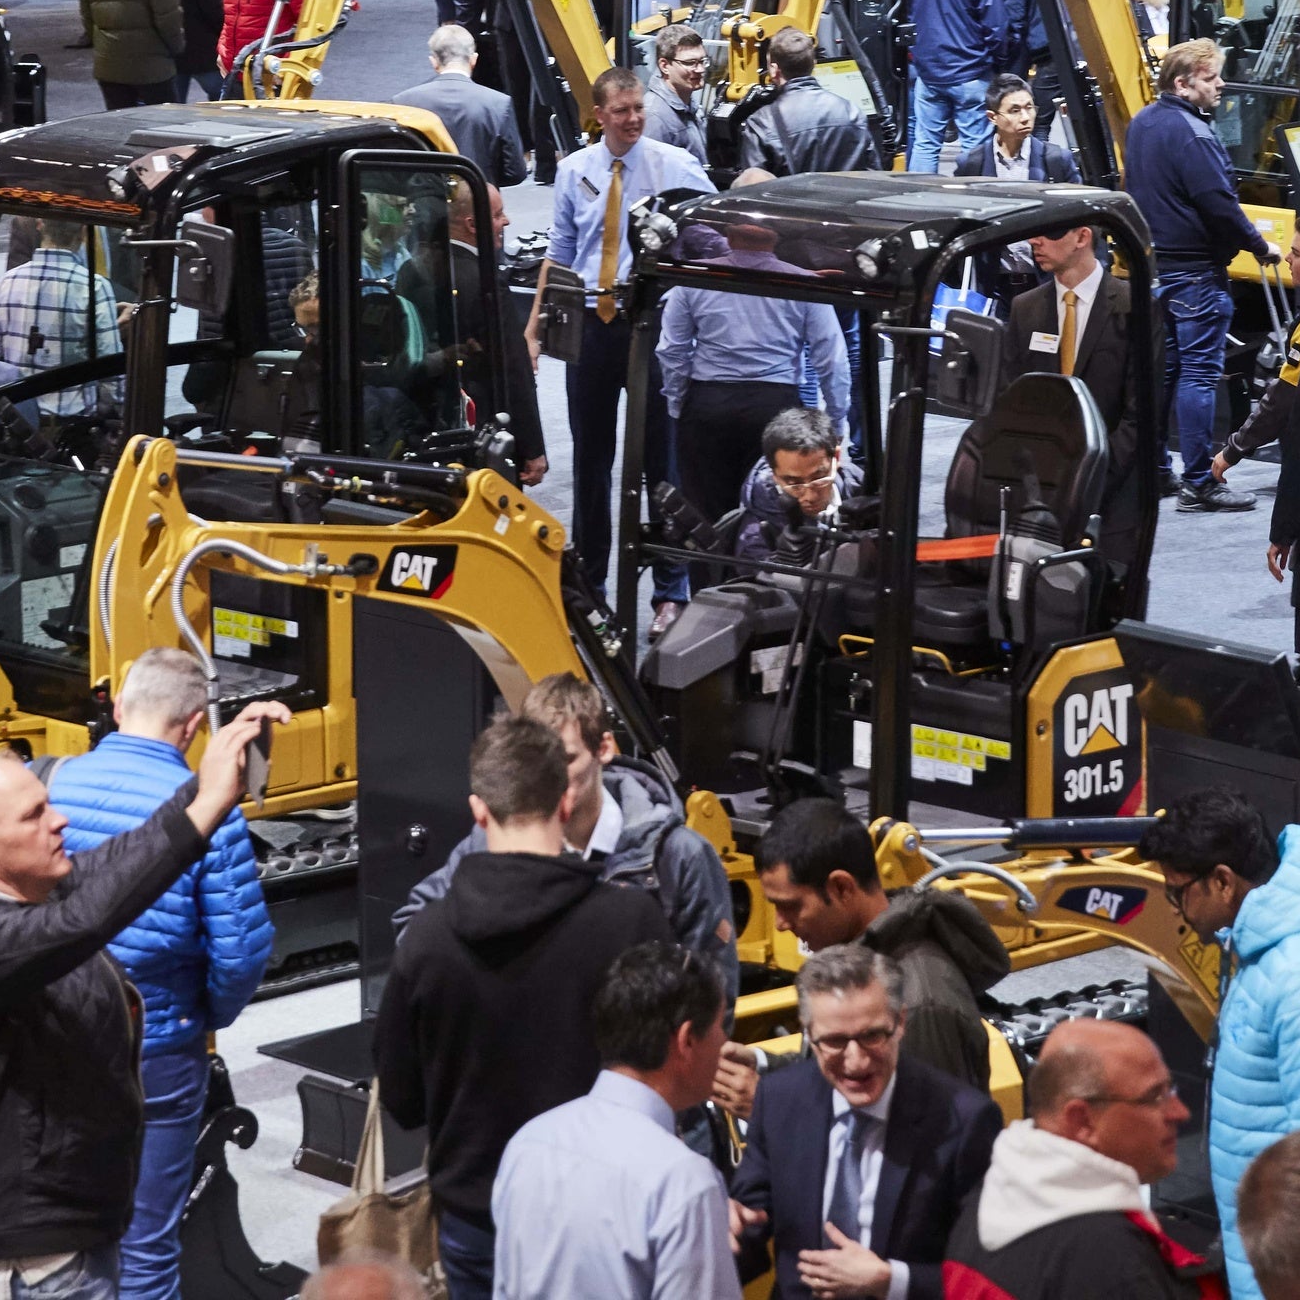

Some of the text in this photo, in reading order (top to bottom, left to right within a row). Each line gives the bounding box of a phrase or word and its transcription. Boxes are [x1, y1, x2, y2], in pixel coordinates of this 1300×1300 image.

[391, 551, 437, 592] CAT
[1063, 684, 1134, 756] CAT
[1064, 758, 1124, 803] 301.5
[1085, 887, 1123, 922] CAT
